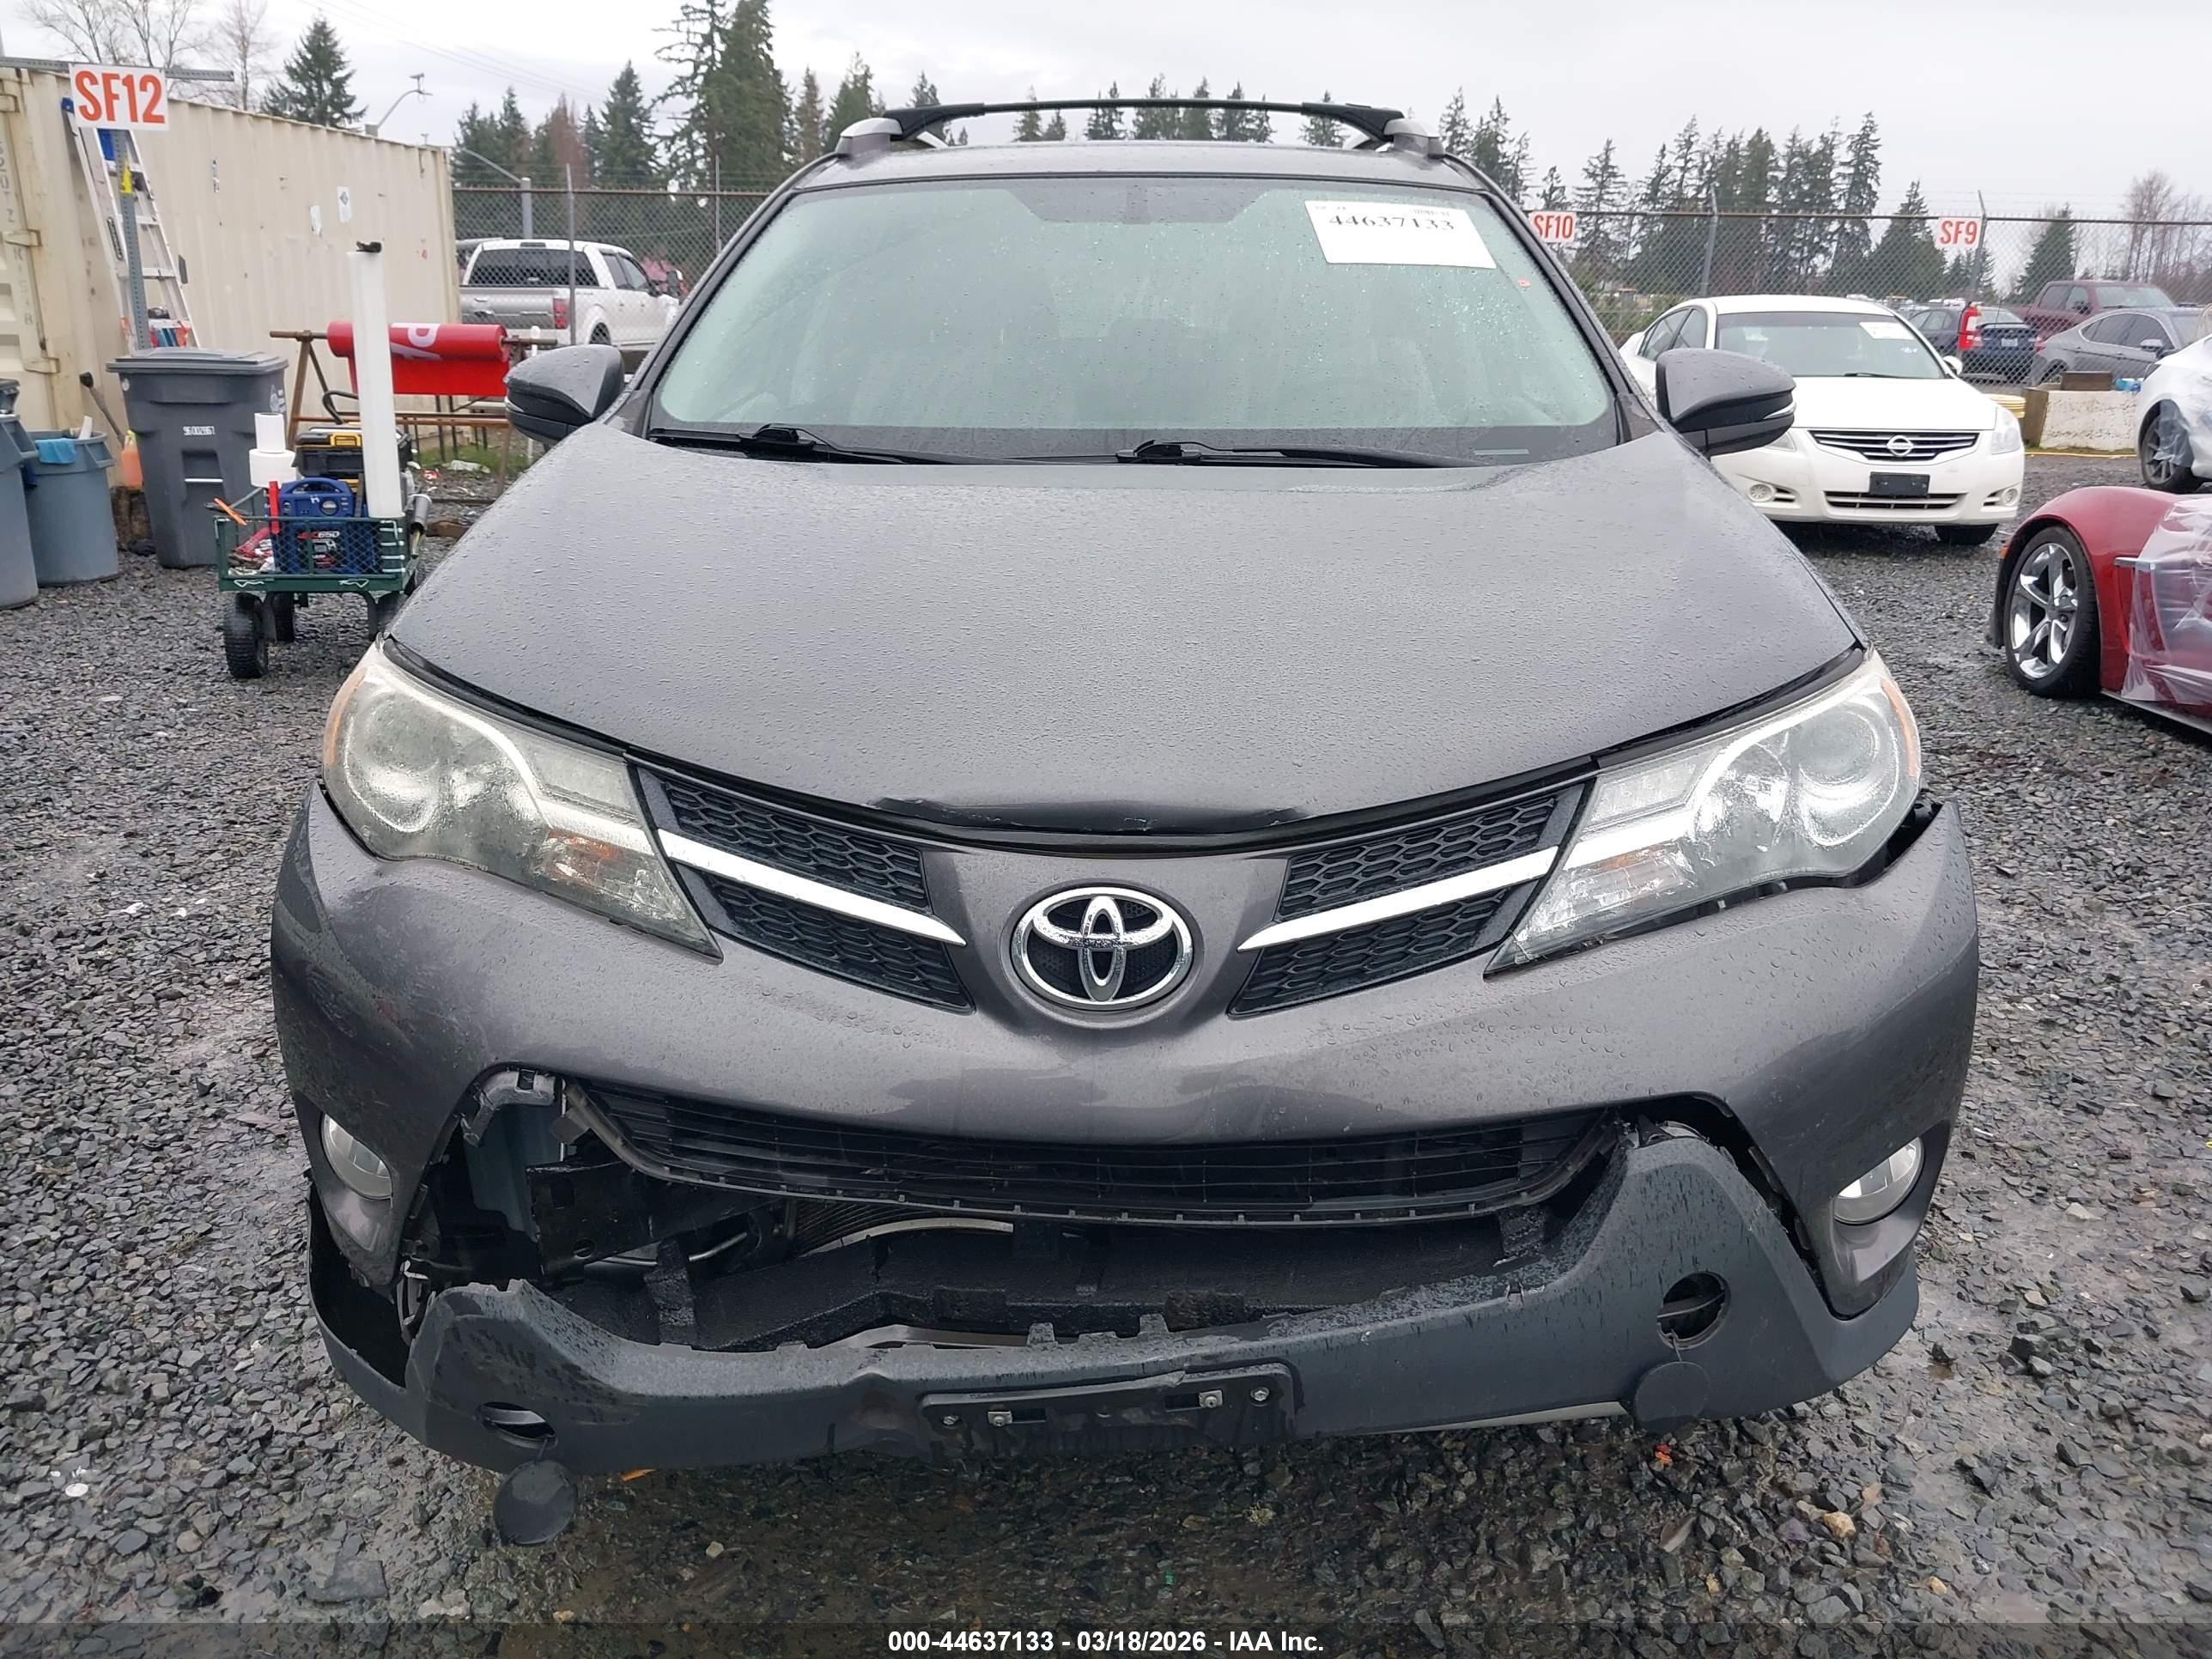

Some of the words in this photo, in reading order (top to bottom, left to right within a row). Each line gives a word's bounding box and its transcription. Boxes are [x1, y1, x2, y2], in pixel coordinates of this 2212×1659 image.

[75, 70, 166, 124] SF12
[1329, 215, 1454, 230] 44637133
[1534, 214, 1573, 239] SF10
[1940, 220, 1978, 245] SF9
